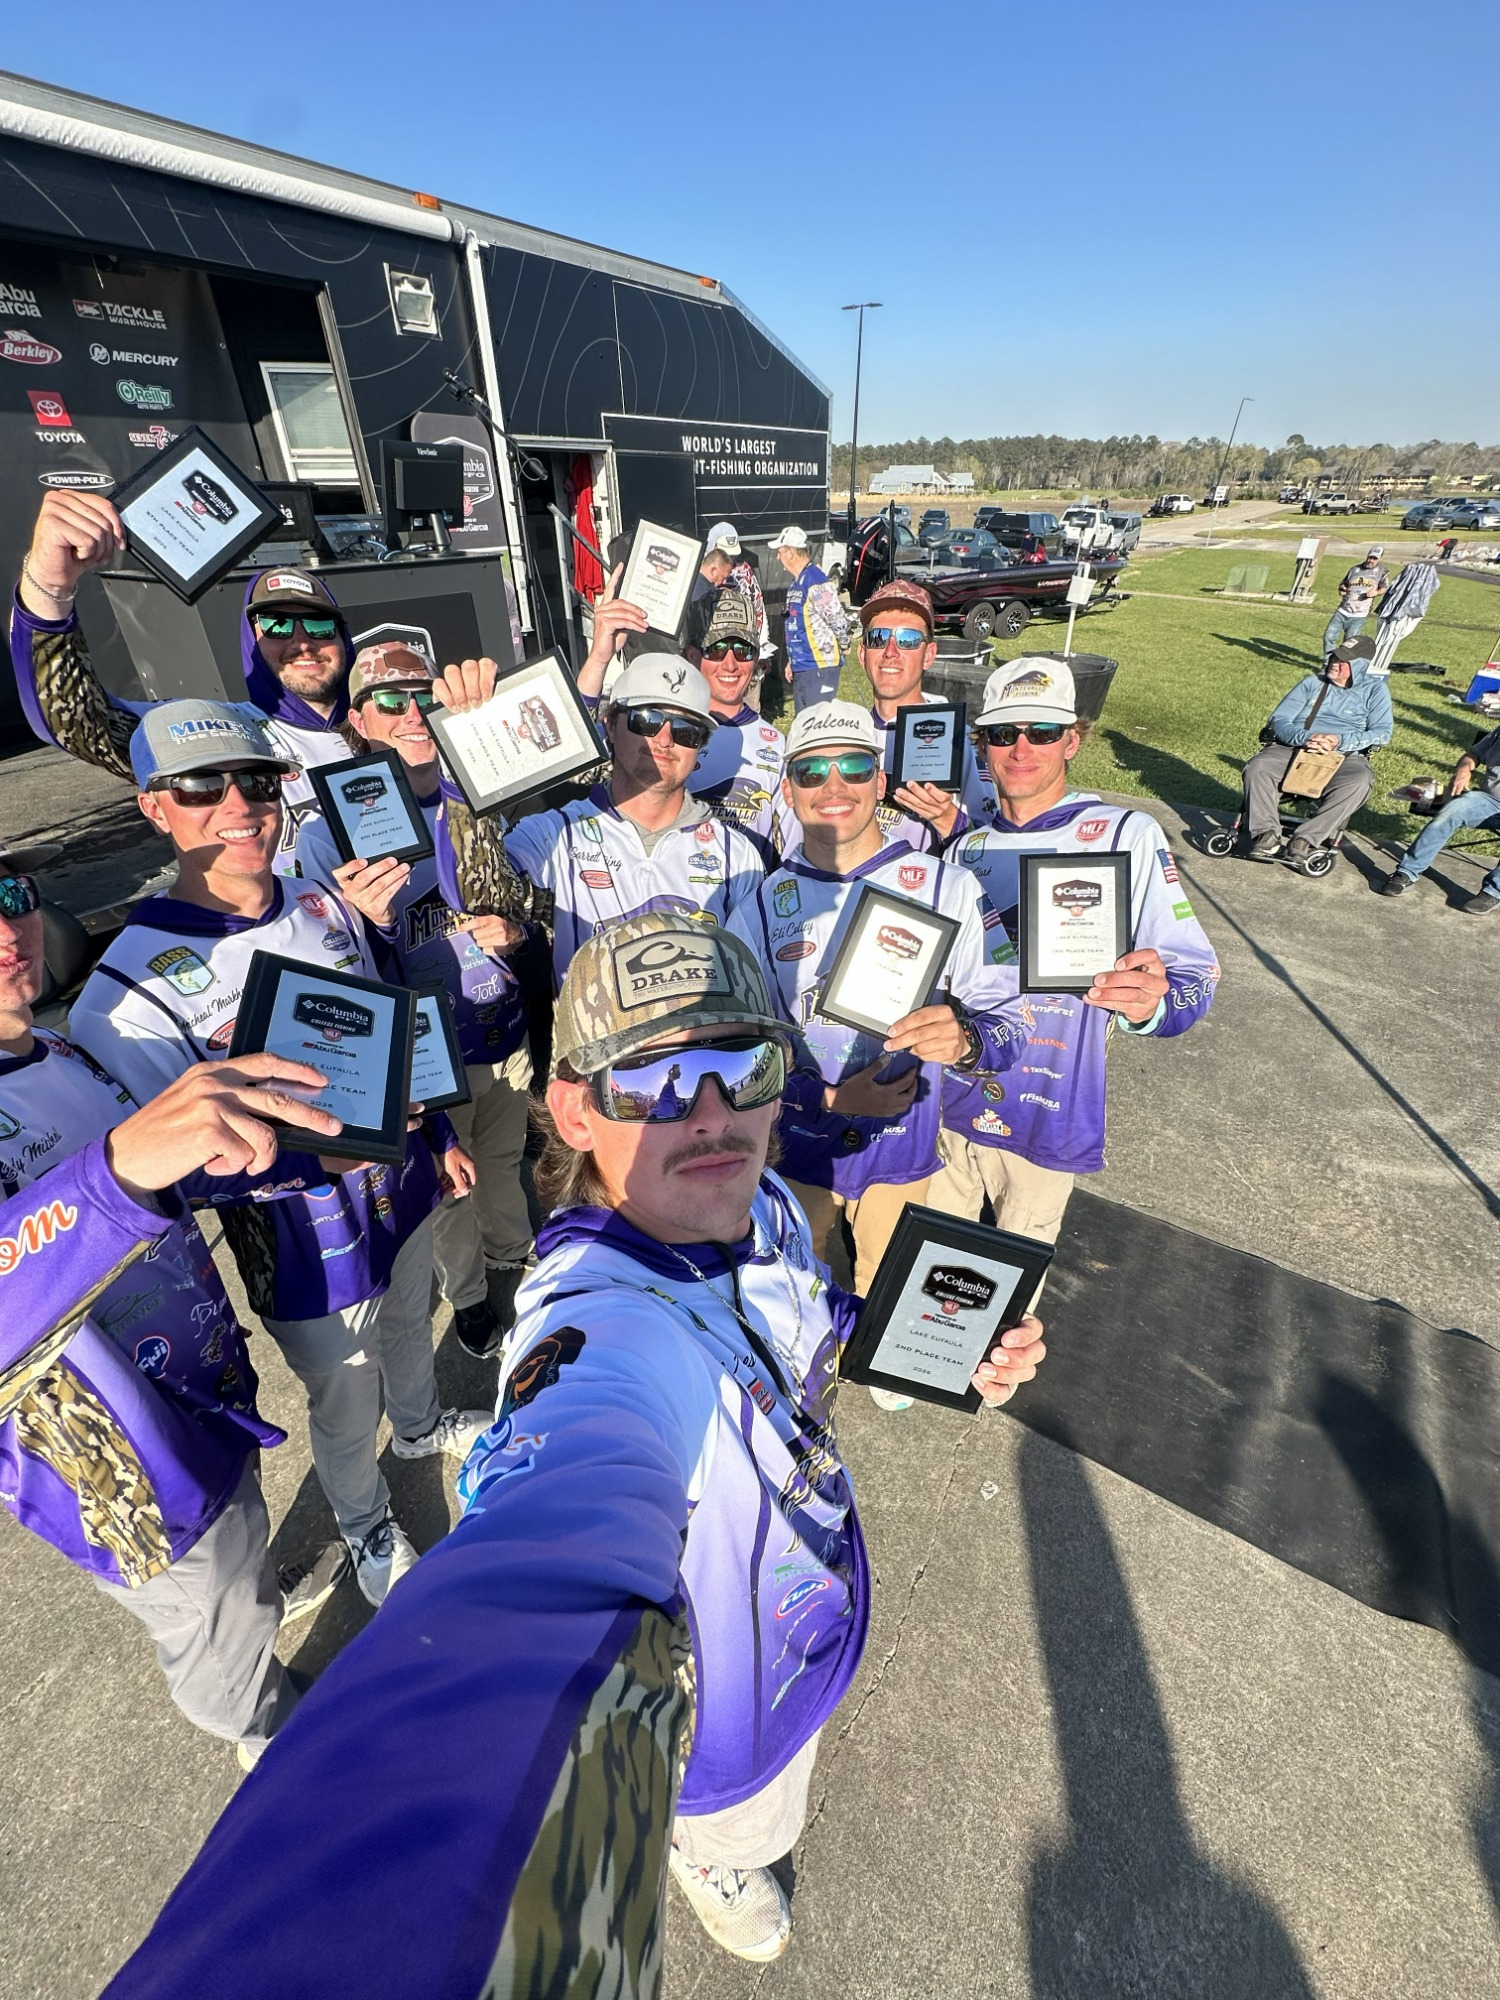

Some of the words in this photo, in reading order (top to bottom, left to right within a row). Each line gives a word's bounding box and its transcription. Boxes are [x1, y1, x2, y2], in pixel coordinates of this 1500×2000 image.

[0, 283, 36, 303] Abu
[0, 301, 42, 318] arcia
[102, 302, 165, 322] TACKLE
[109, 316, 167, 330] WAREHOUSE
[4, 342, 54, 362] Berkley
[113, 350, 179, 367] MERCURY
[119, 382, 170, 406] O'Reilly
[36, 431, 86, 444] TOYOTA
[682, 435, 731, 454] WORLD'S
[735, 438, 776, 455] LARGEST
[464, 458, 485, 472] mbia
[754, 461, 819, 476] ORGANIZATION
[47, 475, 107, 485] POWER-POLE
[200, 482, 234, 516] Columbia
[159, 523, 179, 542] PLACE
[282, 578, 311, 589] TOYOTA
[801, 713, 860, 738] Falcons
[761, 730, 778, 738] MLF
[352, 781, 382, 793] Columbia
[1080, 823, 1104, 834] MLF
[569, 846, 601, 862] Garrett
[902, 870, 923, 881] MLF
[1063, 886, 1099, 896] Columbia
[771, 927, 786, 944] Eli
[150, 947, 193, 973] BASS
[631, 967, 717, 992] DRAKE
[633, 990, 647, 999] THE
[647, 983, 687, 996] WATERFOWL
[315, 1002, 369, 1022] Columbia
[1029, 1004, 1075, 1018] AmFirst
[325, 1030, 340, 1039] MLF
[1027, 1037, 1068, 1051] SIMMS
[320, 1063, 360, 1076] EUFAULA
[412, 1074, 426, 1082] LACE
[341, 1086, 366, 1096] TEAM
[310, 1100, 334, 1109] 2026
[1026, 1093, 1060, 1109] FishUSA
[944, 1274, 990, 1296] Columbia
[910, 1329, 929, 1338] LAKE
[930, 1335, 963, 1348] EUFAULA
[895, 1344, 912, 1352] 2ND
[914, 1348, 940, 1360] PLACE
[942, 1356, 964, 1366] TEAM
[913, 1366, 932, 1375] 2026
